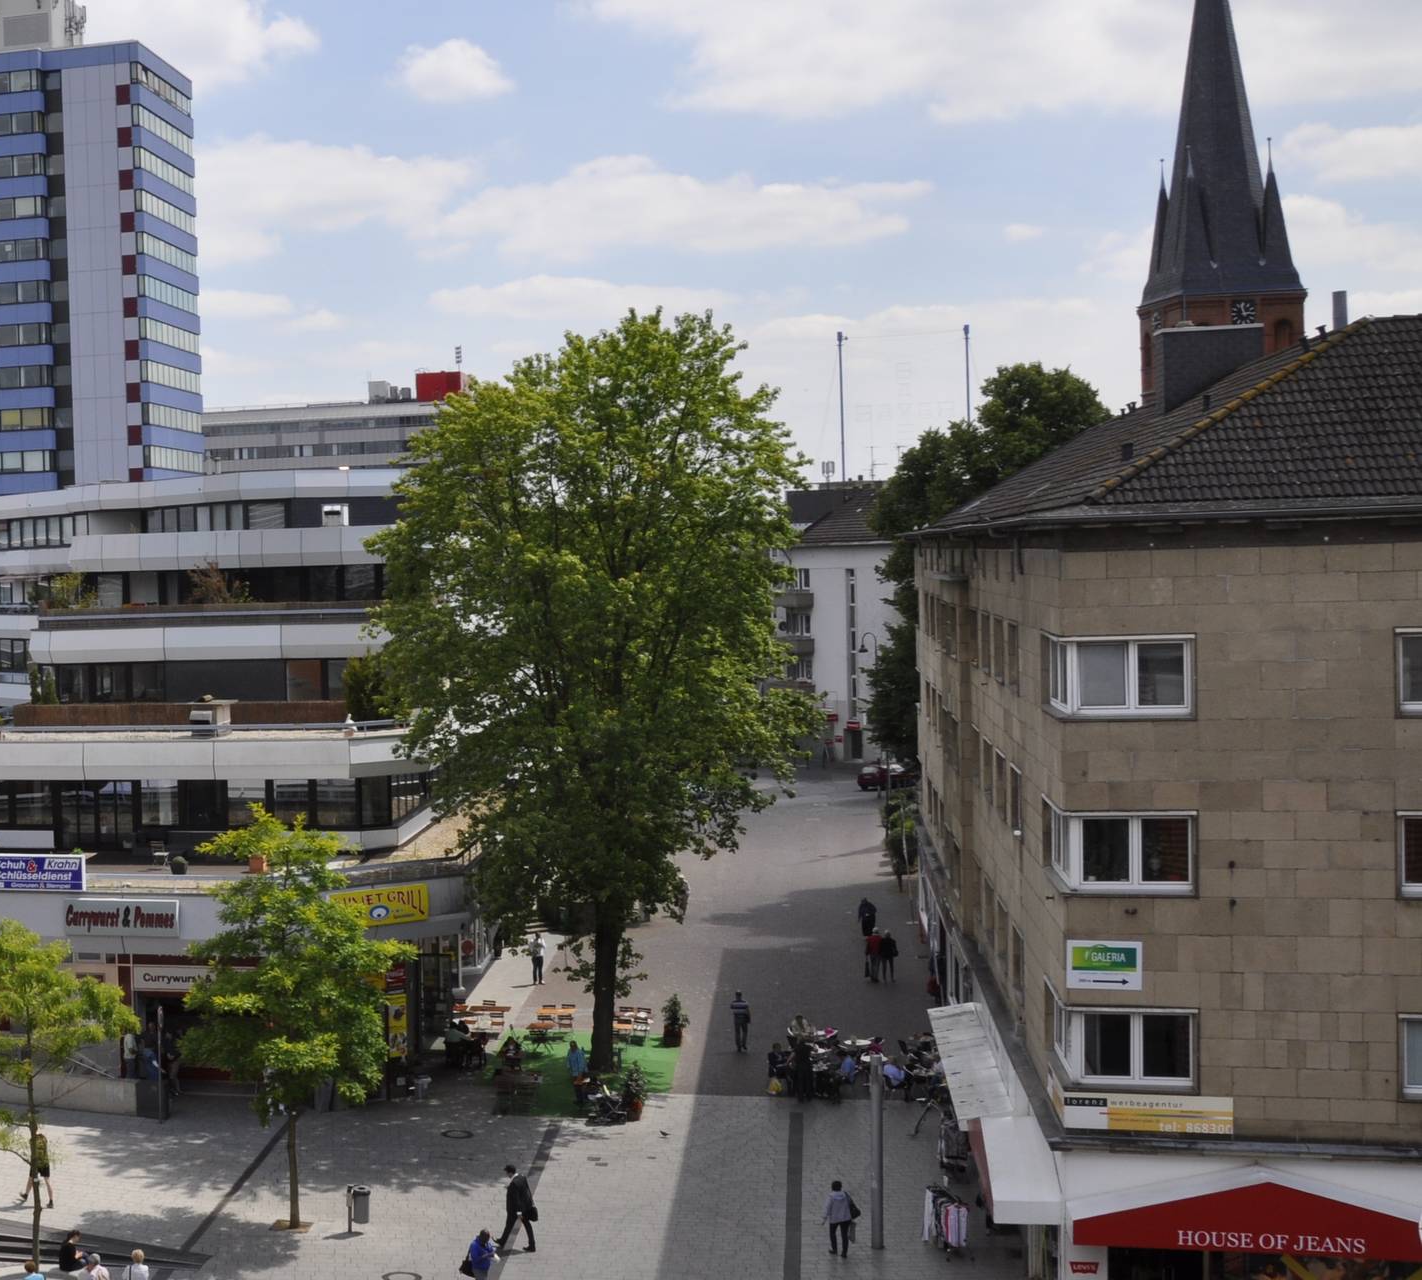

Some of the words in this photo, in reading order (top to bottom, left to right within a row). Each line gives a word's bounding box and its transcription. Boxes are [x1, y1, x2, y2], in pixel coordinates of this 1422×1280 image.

[44, 859, 78, 870] Krahn
[66, 904, 119, 933] Currywurst
[122, 905, 131, 927] &
[134, 905, 175, 929] Pommes
[1177, 1230, 1254, 1249] HOUSE
[1258, 1233, 1289, 1249] OF
[1293, 1235, 1366, 1254] JEANS
